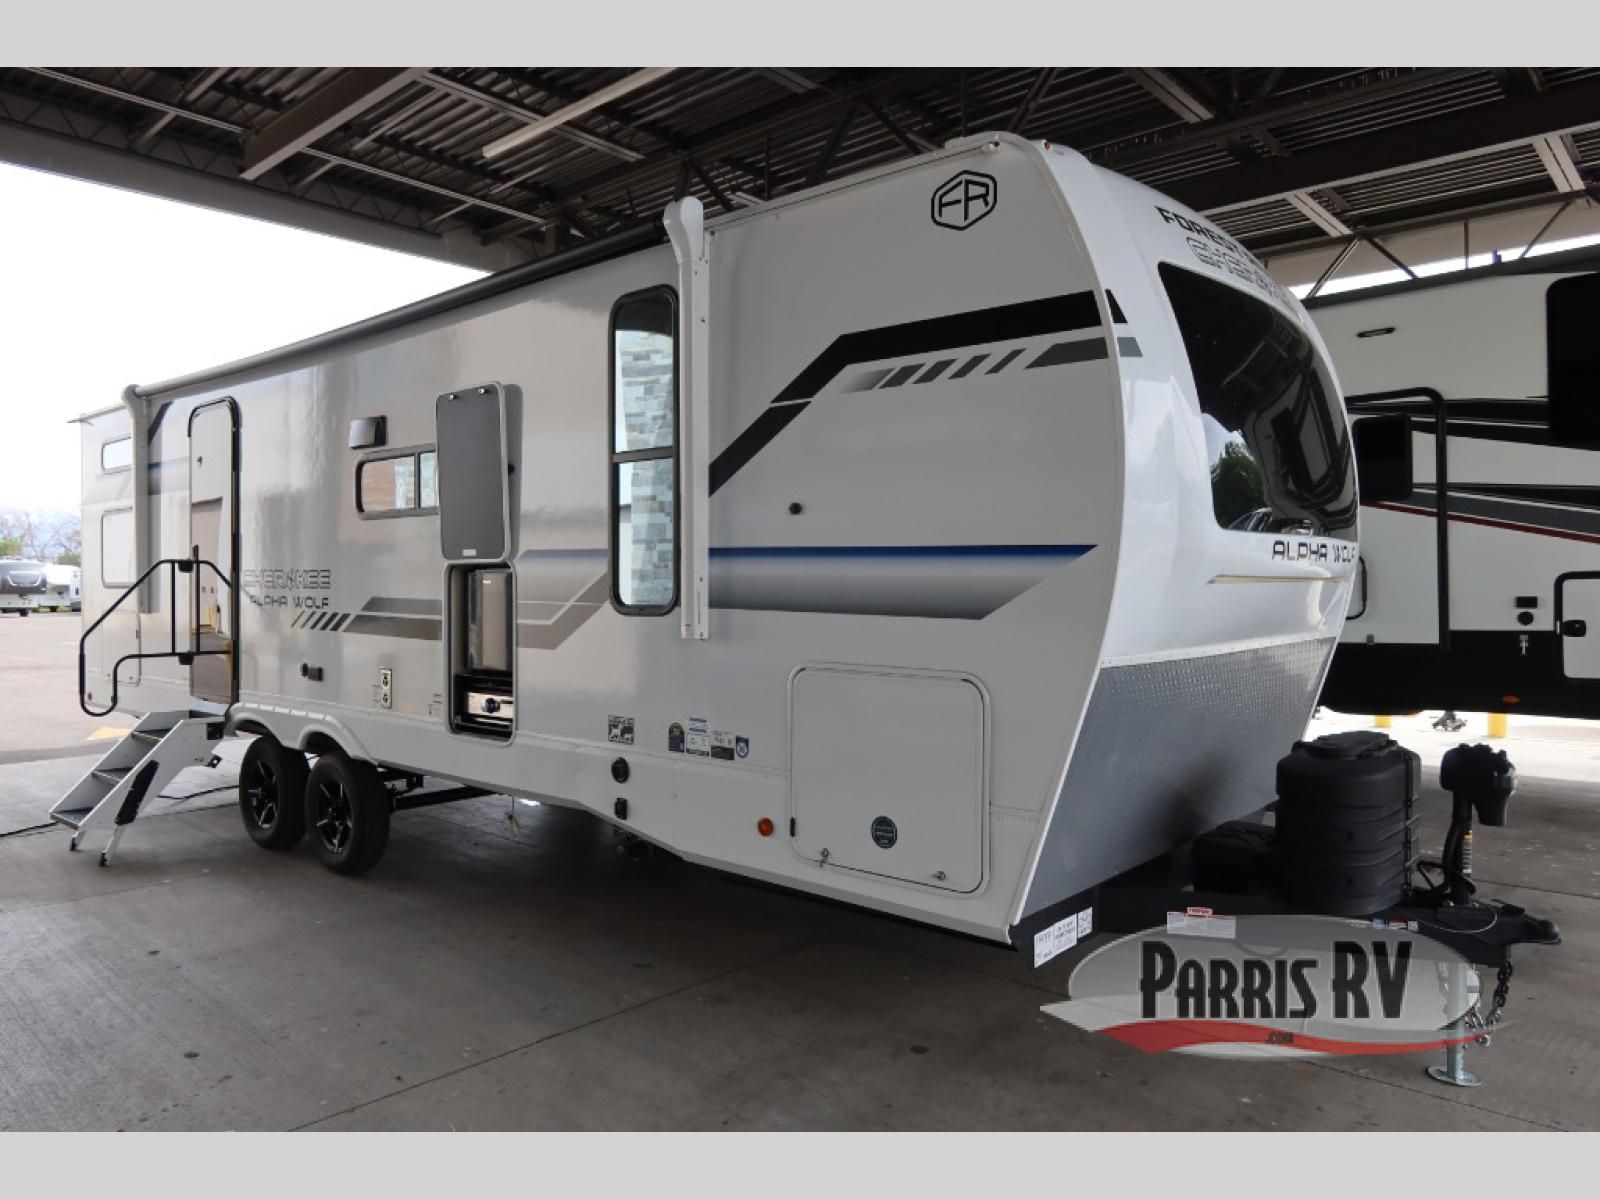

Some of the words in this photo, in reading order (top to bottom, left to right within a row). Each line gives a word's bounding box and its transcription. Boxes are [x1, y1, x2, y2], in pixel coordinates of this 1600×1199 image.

[1271, 540, 1328, 562] ALPHA
[248, 594, 288, 607] ALPHA
[293, 595, 330, 609] WOLF
